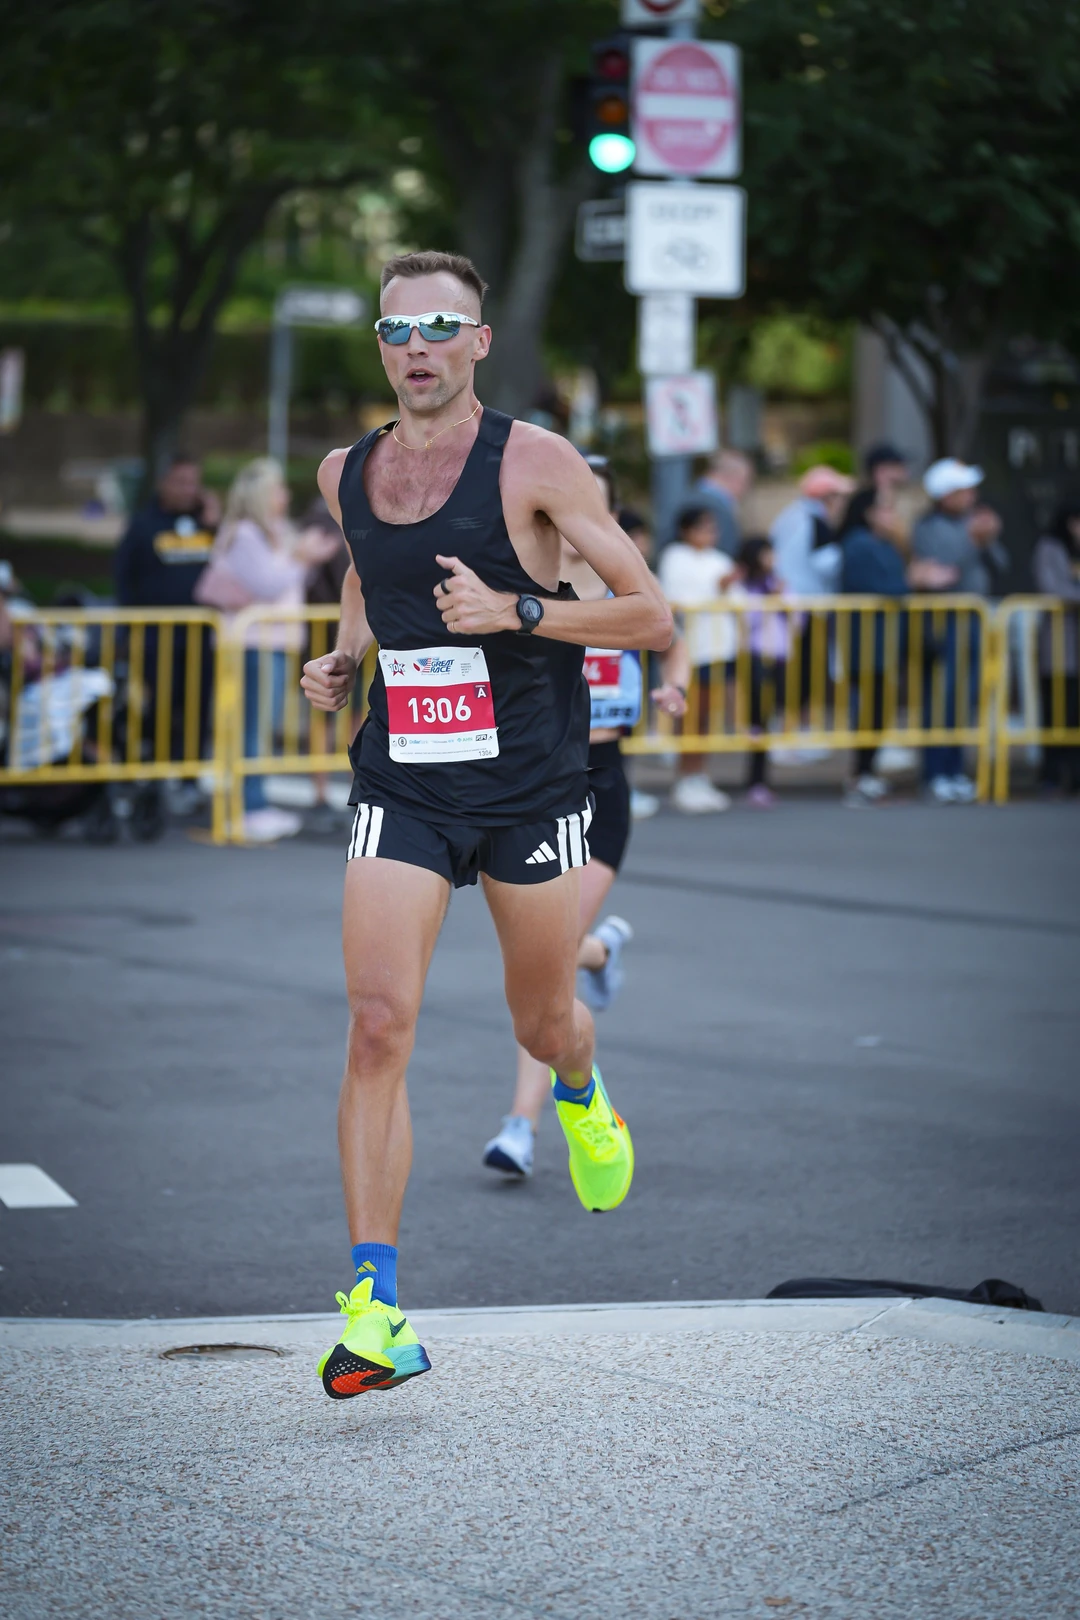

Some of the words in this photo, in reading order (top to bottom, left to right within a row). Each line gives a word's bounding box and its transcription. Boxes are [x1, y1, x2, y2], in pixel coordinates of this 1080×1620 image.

[388, 663, 406, 673] 10K
[431, 659, 455, 667] GREAT
[477, 688, 487, 698] A
[408, 695, 471, 722] 1306
